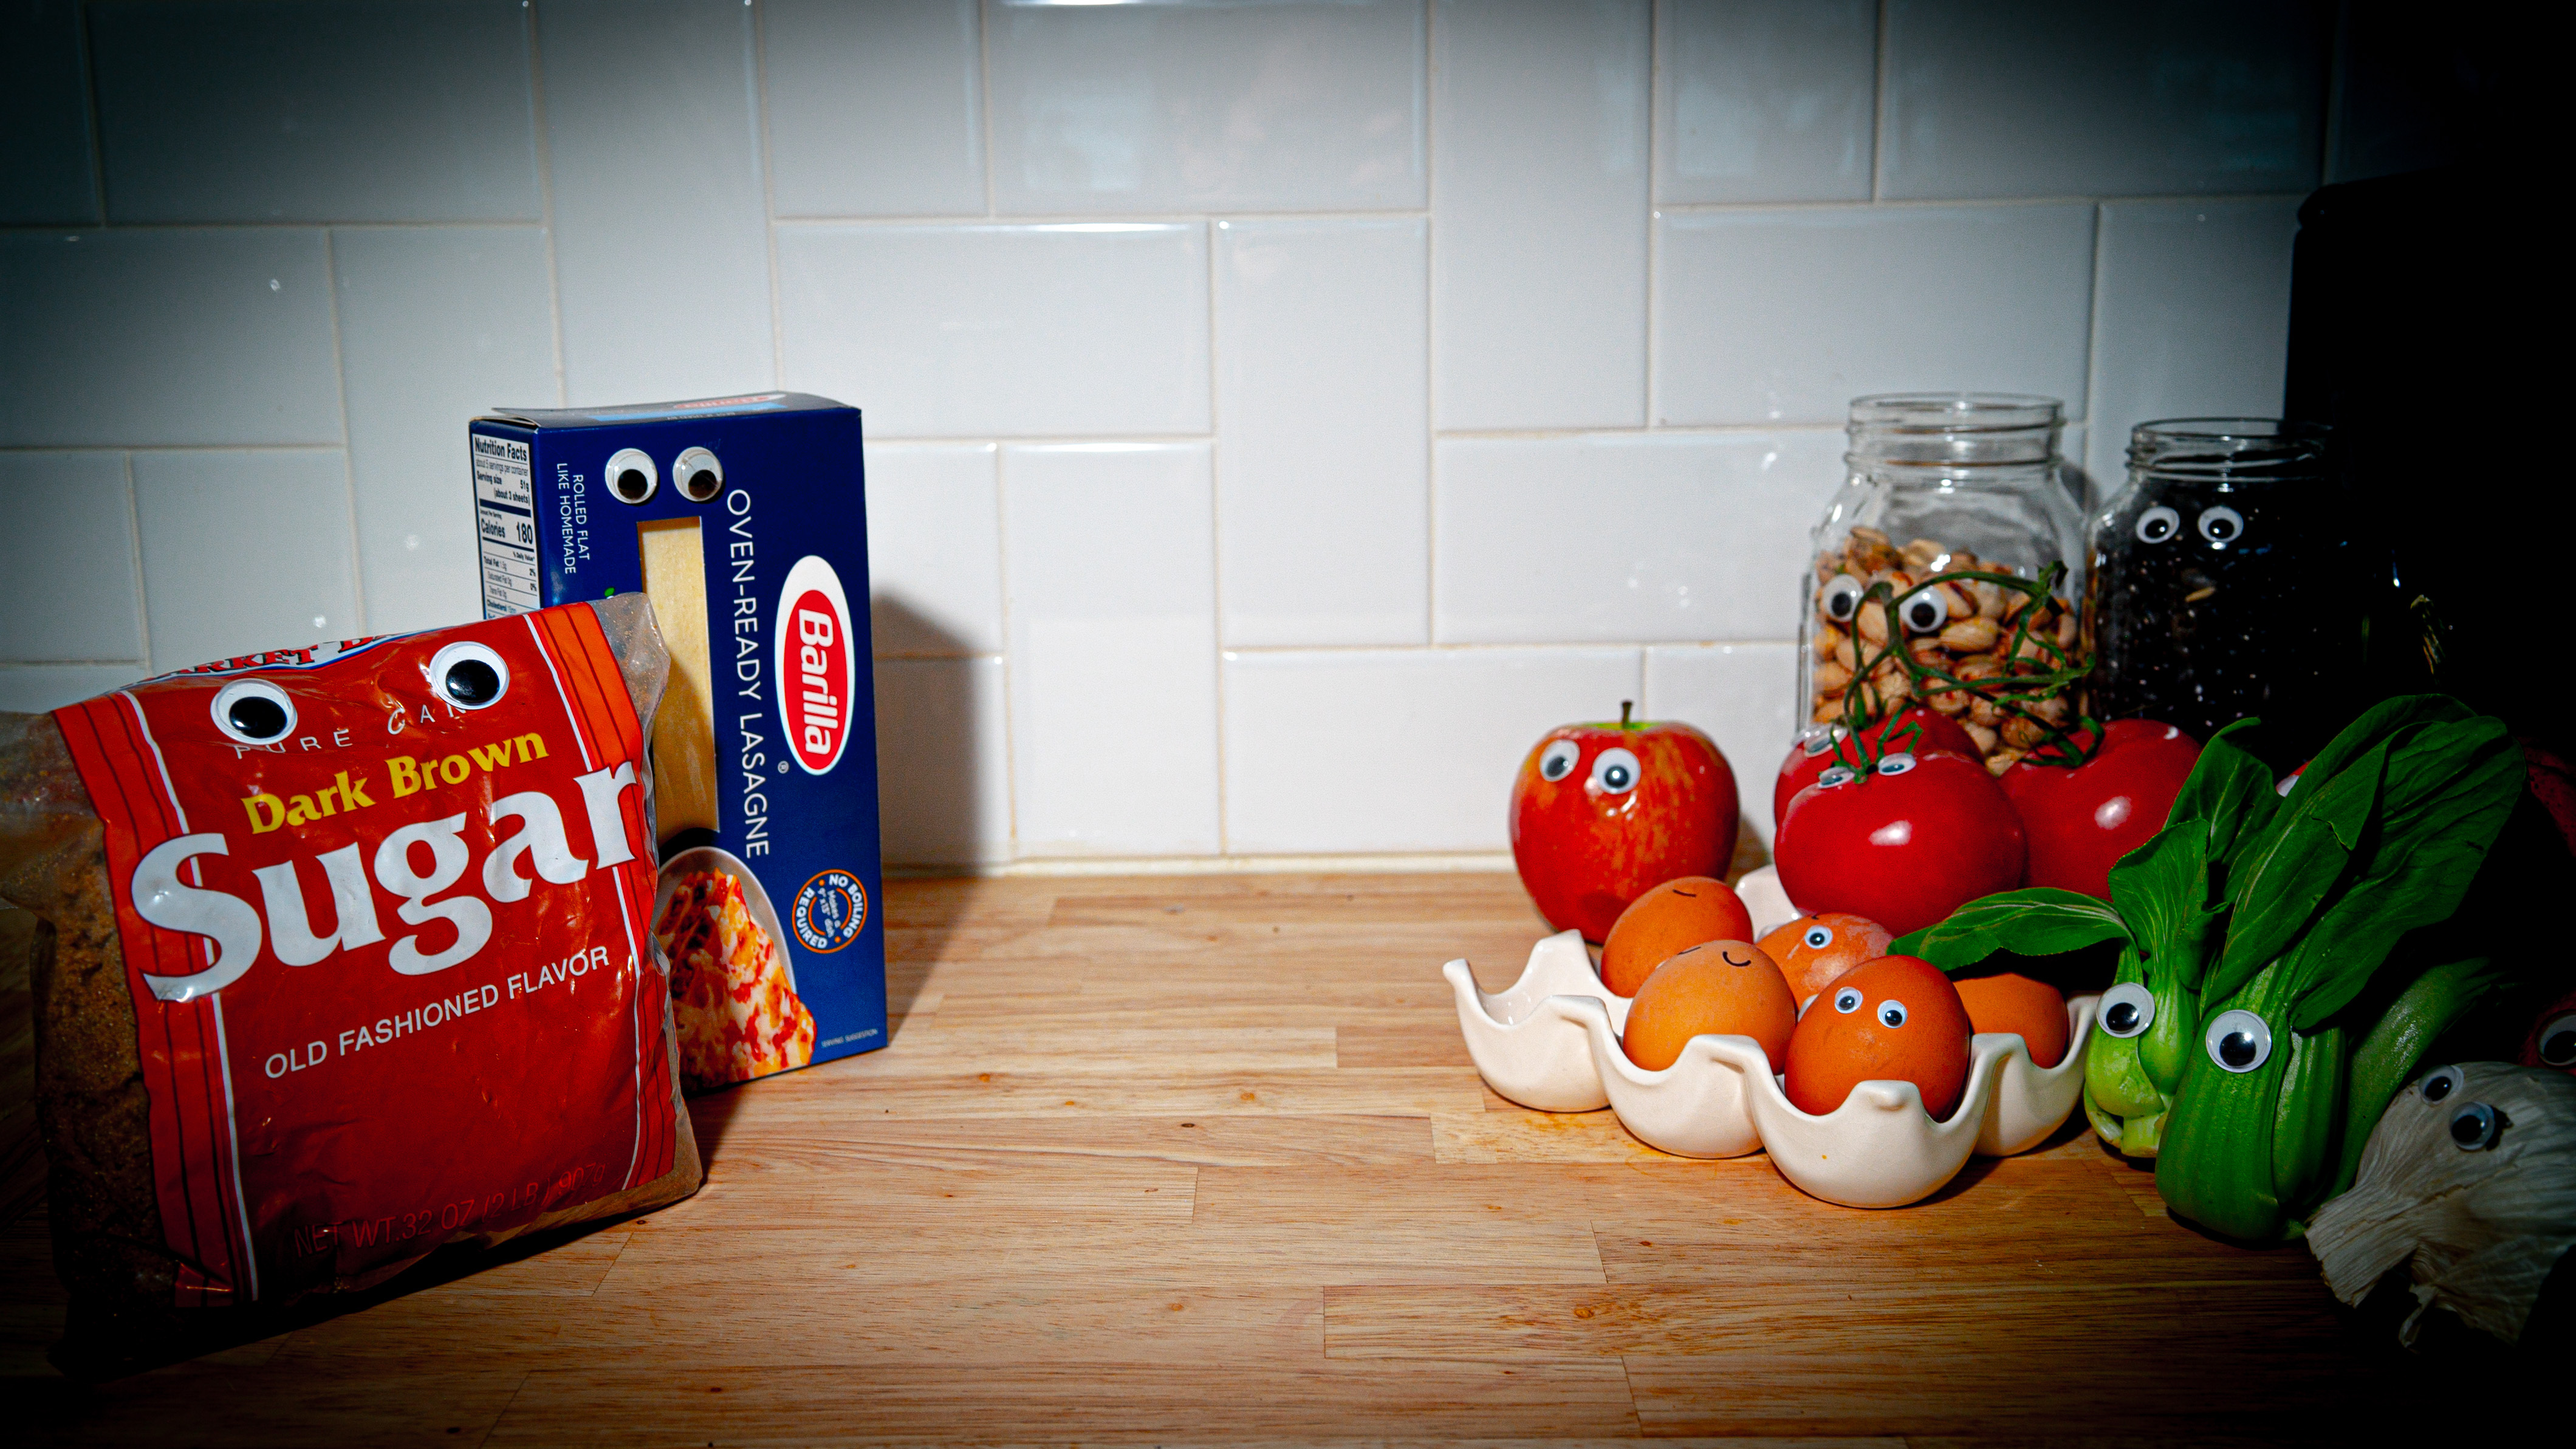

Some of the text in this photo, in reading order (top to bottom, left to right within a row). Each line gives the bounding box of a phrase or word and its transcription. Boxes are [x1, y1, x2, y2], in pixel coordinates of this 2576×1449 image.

[475, 437, 527, 461] Nutrition Facts
[477, 471, 529, 492] Serving size 51g
[481, 518, 533, 545] Calories 180
[557, 463, 577, 574] LIKE HOMEMADE
[573, 474, 590, 560] ROLLED FLAT
[727, 489, 769, 858] OVEN-READY LASAGNE
[799, 609, 838, 755] Barilla
[241, 732, 548, 834] Dark Brown
[131, 761, 636, 1002] Sugar
[796, 874, 863, 948] NO BOILING REQUIRED
[265, 945, 609, 1078] OLD FASHIONED FLAVOR
[294, 1221, 344, 1258] NET
